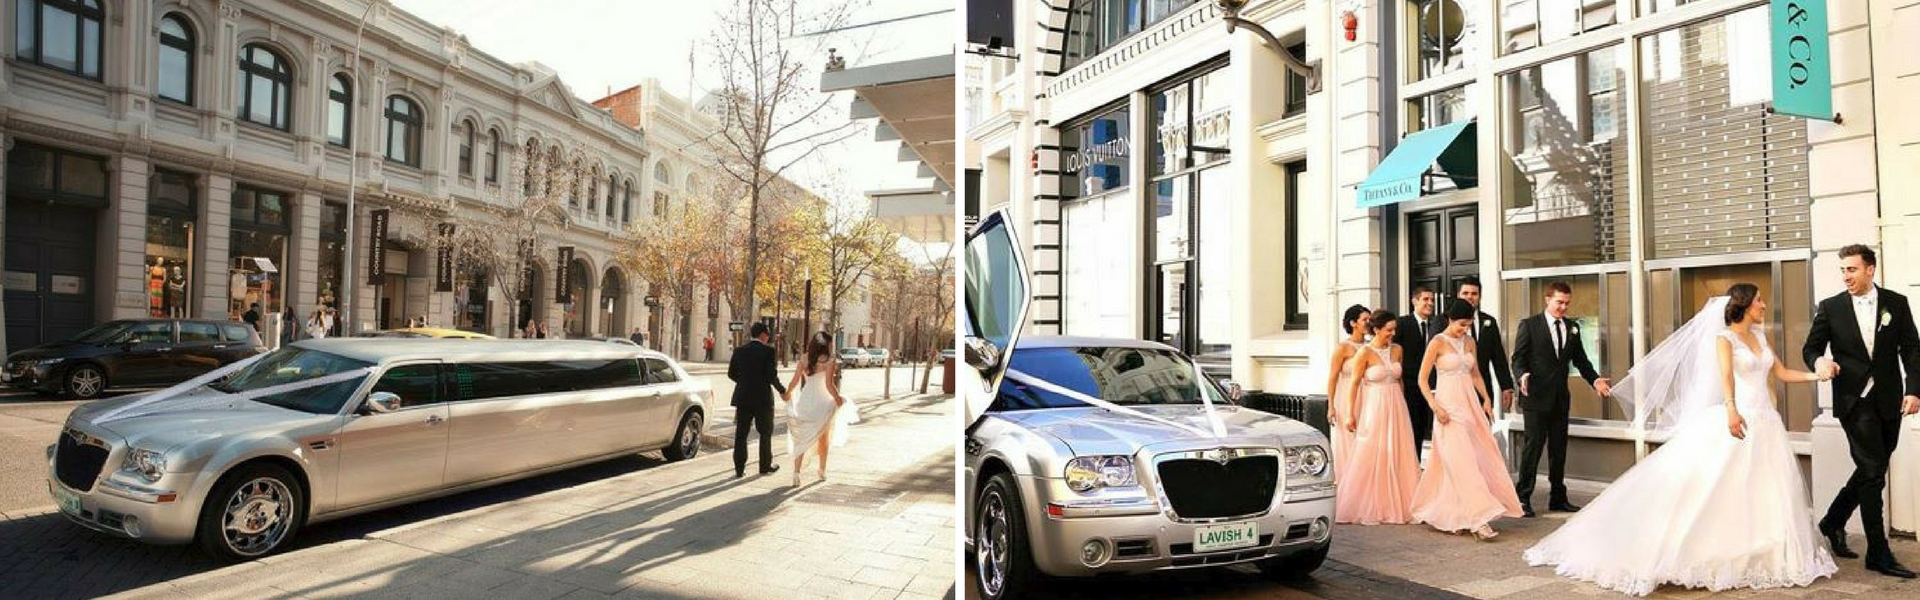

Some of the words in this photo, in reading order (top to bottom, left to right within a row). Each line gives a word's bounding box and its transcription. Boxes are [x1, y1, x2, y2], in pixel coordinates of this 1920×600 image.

[1788, 2, 1808, 29] &
[1092, 135, 1131, 163] VUITTON
[1200, 528, 1242, 545] LAVISH
[1246, 527, 1254, 539] 4
